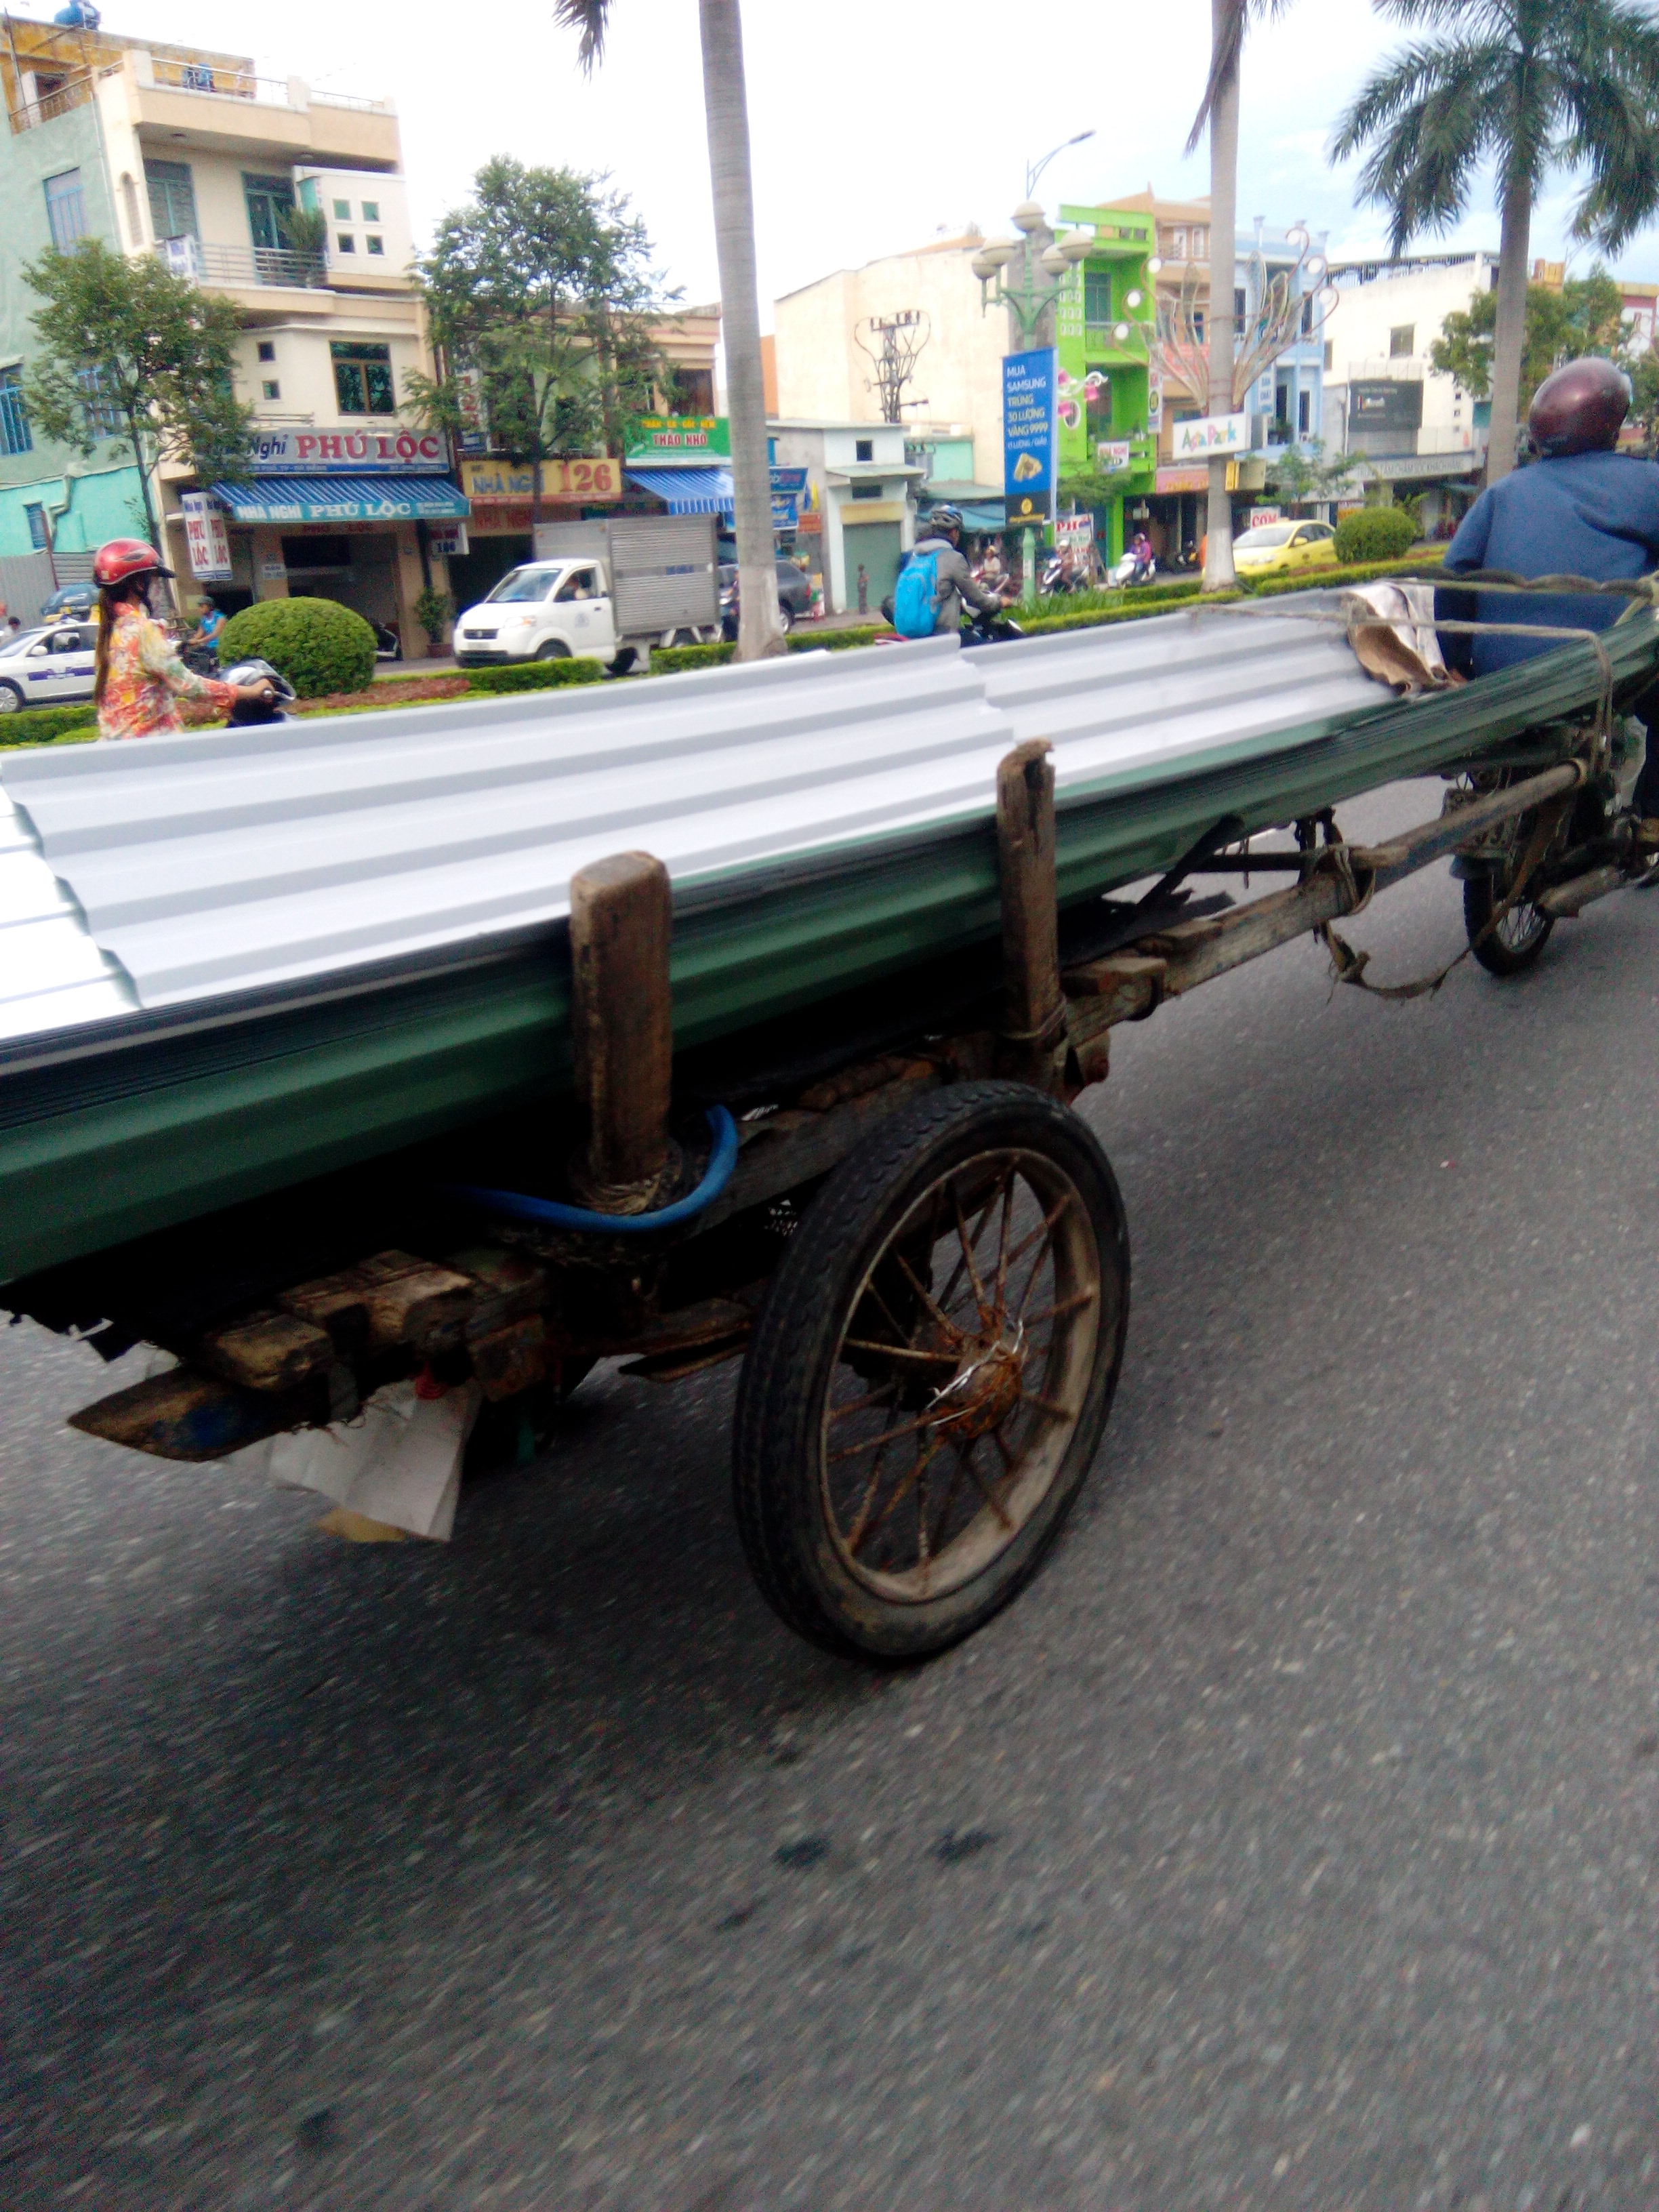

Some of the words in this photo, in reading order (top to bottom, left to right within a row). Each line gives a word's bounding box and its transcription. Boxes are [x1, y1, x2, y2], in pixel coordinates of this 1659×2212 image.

[1006, 365, 1026, 377] MUA
[1006, 376, 1047, 392] SAMSUNG
[295, 429, 367, 459] PHÚ
[375, 429, 440, 464] LỘC
[1181, 428, 1206, 451] Asia
[1208, 420, 1237, 446] Park
[559, 463, 613, 493] 126
[308, 501, 359, 518] PHÚ
[364, 500, 411, 518] LỘC
